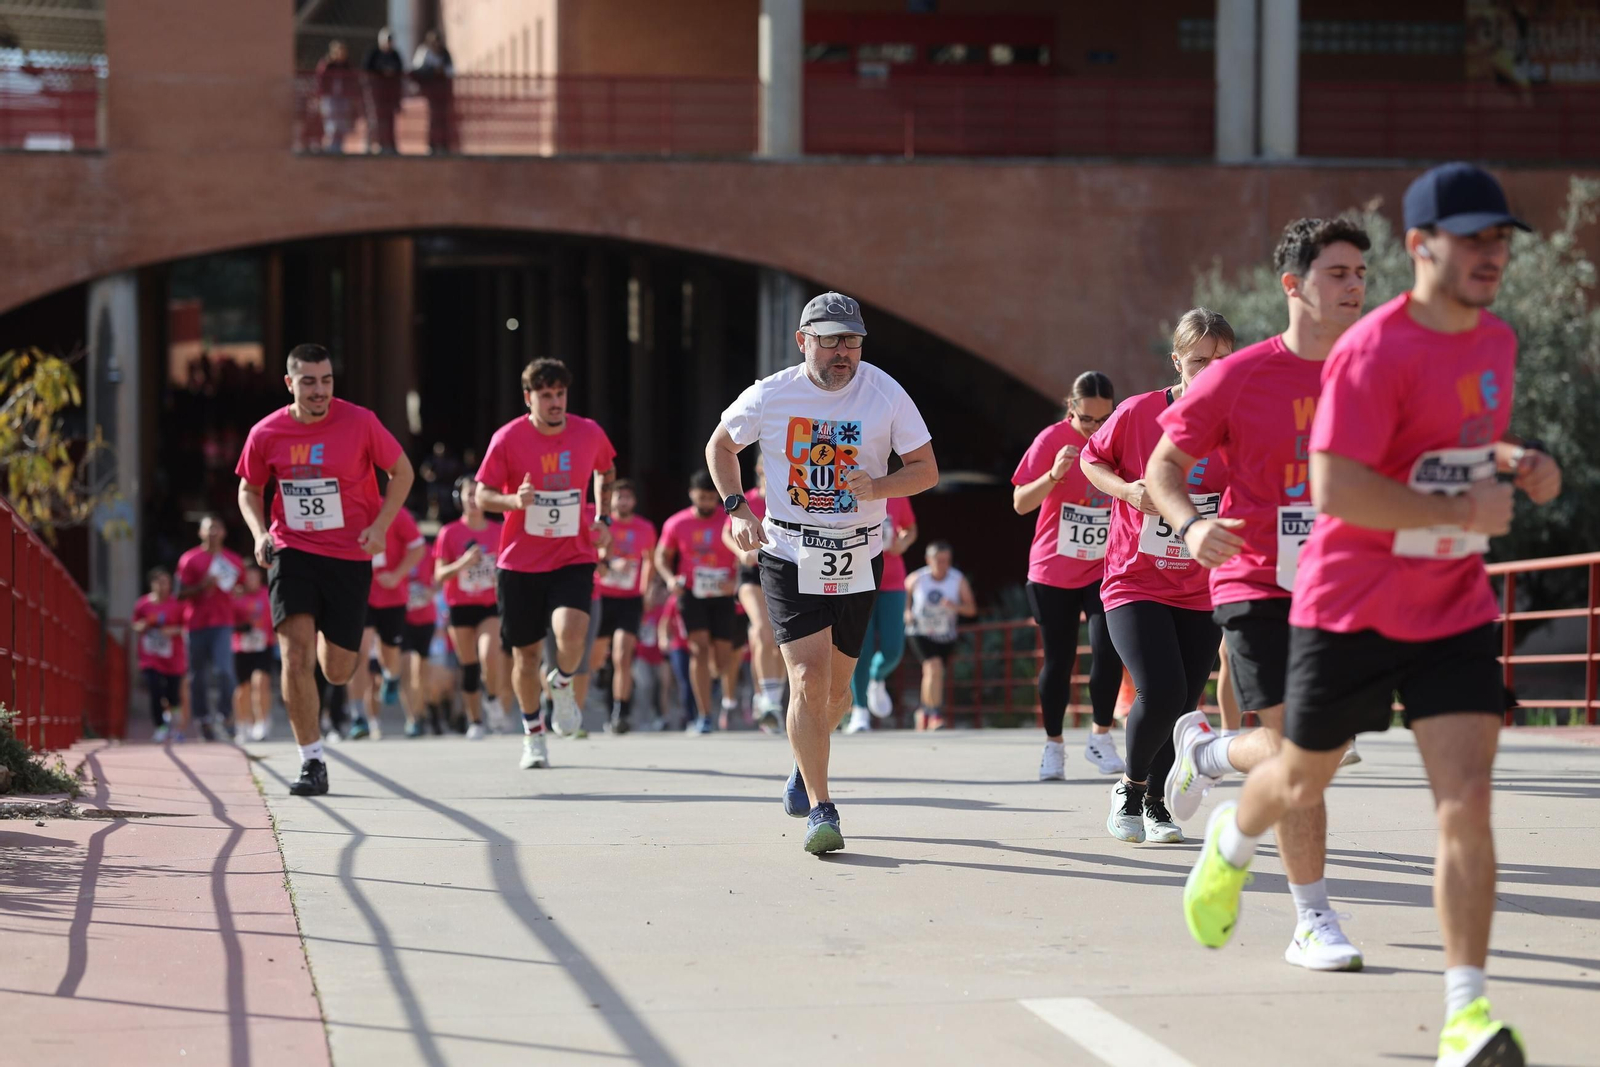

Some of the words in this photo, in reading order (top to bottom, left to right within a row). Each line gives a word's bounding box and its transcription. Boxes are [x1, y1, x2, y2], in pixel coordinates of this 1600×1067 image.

[1292, 396, 1317, 431] W
[290, 443, 325, 465] WE
[541, 450, 572, 473] WE
[1186, 457, 1209, 485] E
[284, 487, 309, 496] UMA
[299, 497, 326, 516] 58
[548, 508, 560, 524] 9
[1064, 511, 1089, 524] UMA
[1069, 525, 1108, 545] 169
[1284, 521, 1315, 534] UM
[805, 536, 838, 549] UMA
[1167, 547, 1180, 556] WE
[821, 552, 853, 577] 32
